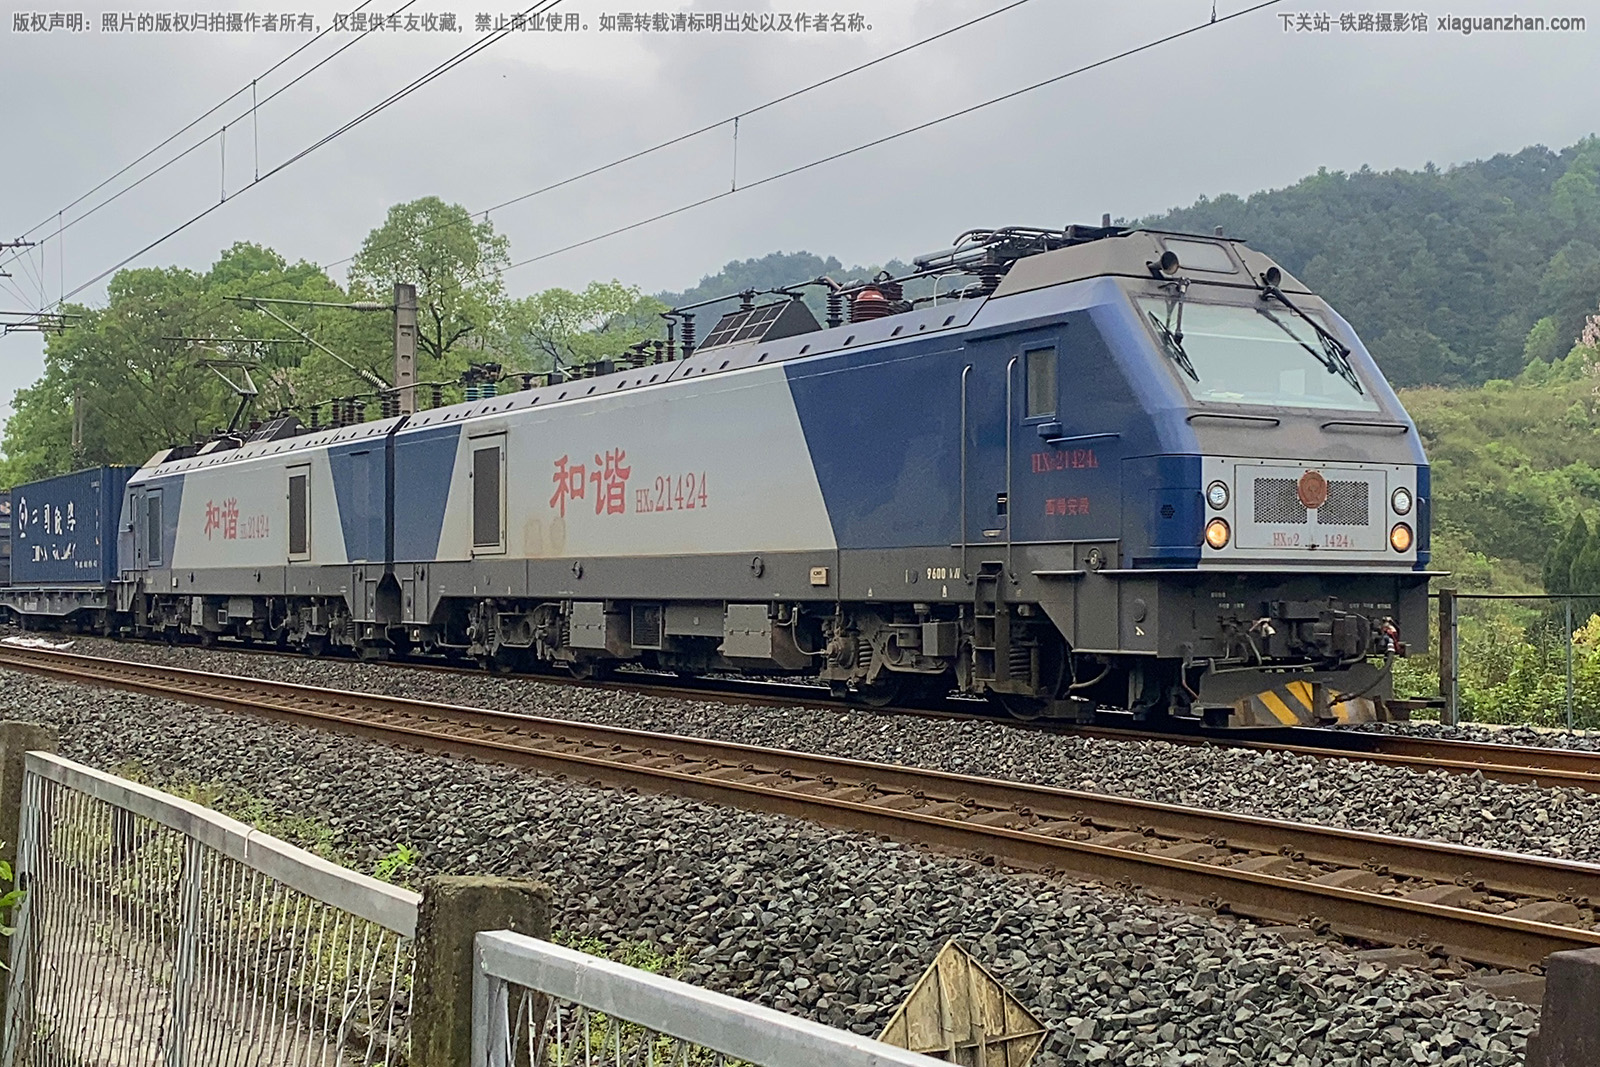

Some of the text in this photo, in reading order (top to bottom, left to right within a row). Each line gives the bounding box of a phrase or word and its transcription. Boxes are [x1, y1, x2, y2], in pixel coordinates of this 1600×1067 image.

[549, 447, 631, 518] 和谐
[204, 497, 239, 541] 和谐
[926, 567, 946, 580] 9600
